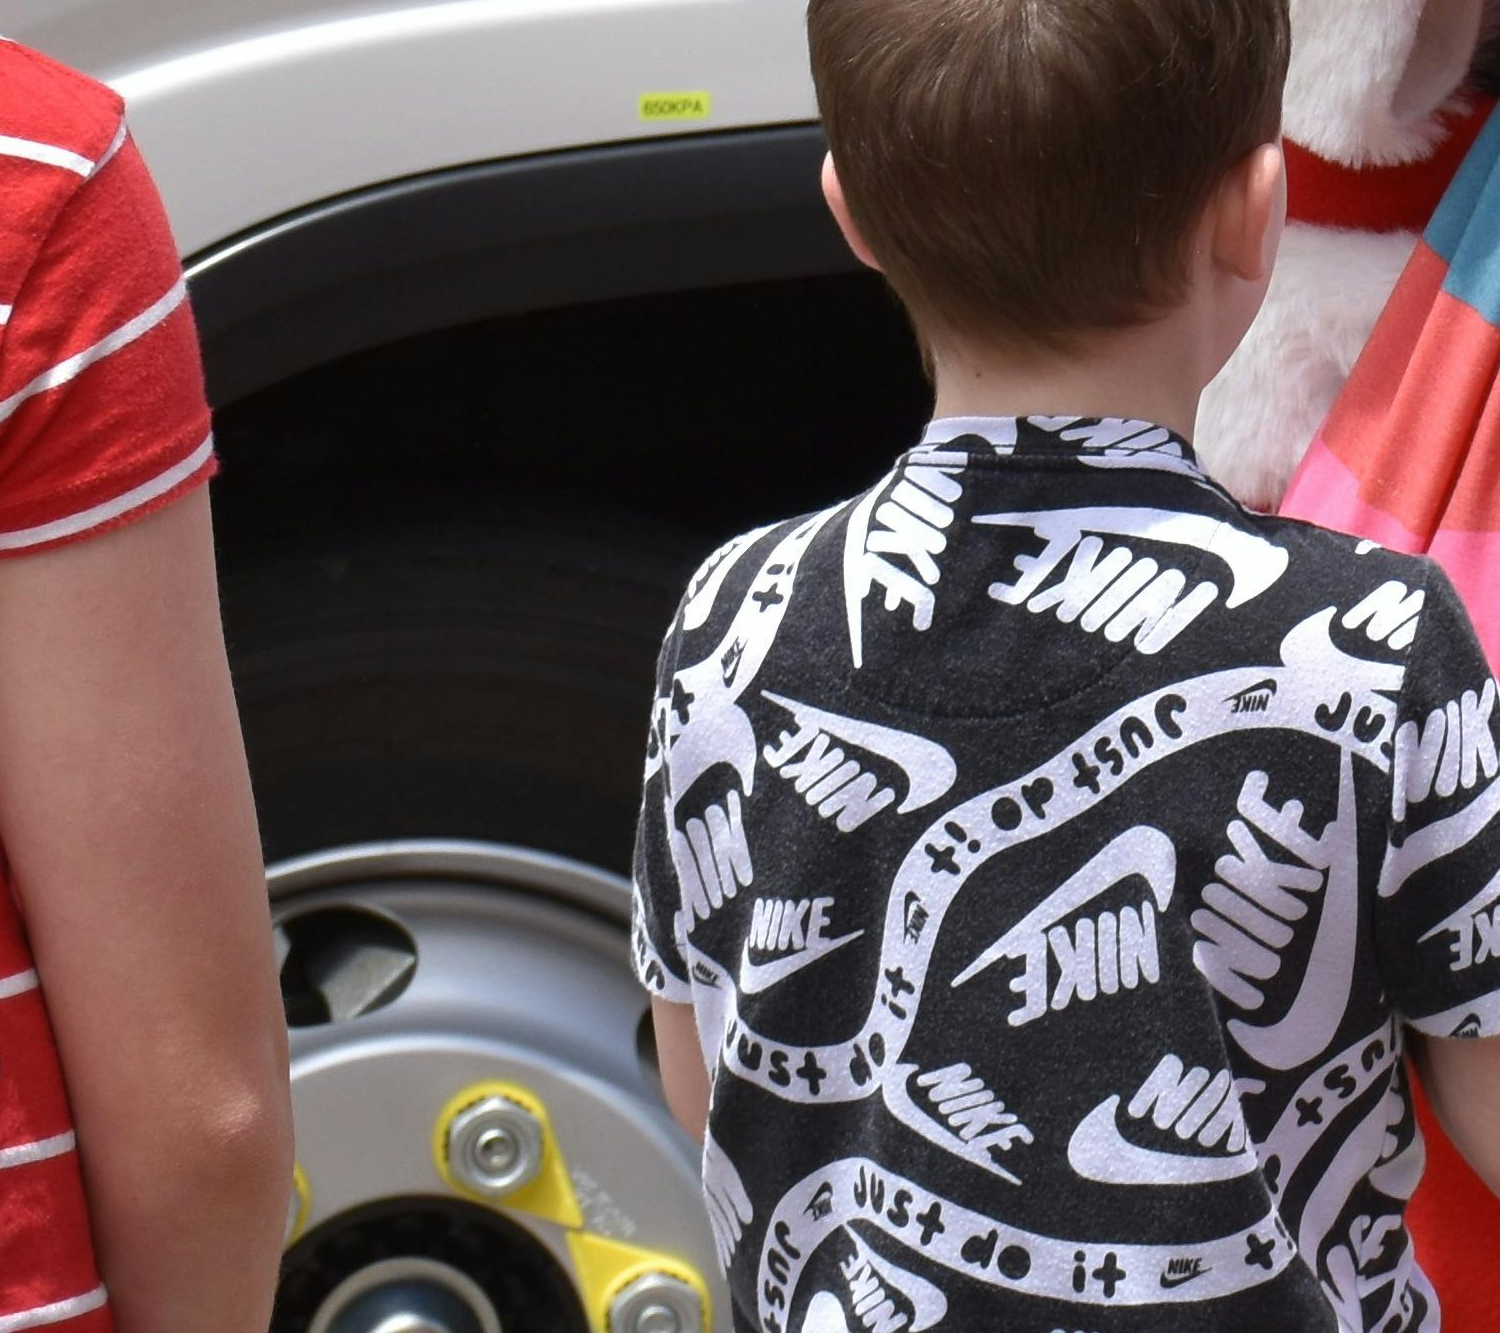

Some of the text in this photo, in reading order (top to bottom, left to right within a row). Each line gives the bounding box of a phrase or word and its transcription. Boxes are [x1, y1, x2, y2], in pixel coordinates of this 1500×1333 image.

[988, 526, 1219, 654] NIKE
[1230, 693, 1271, 715] NIKE
[762, 723, 896, 833] NIKE
[923, 693, 1187, 875] Just do it
[749, 896, 835, 953] NIKE
[1189, 769, 1336, 1010] NIKE
[1007, 900, 1160, 1027] NIKE
[725, 966, 916, 1096] Just do it
[916, 1062, 1034, 1159] NIKE
[853, 1164, 1127, 1299] Just do it
[1167, 1257, 1203, 1277] NIKE
